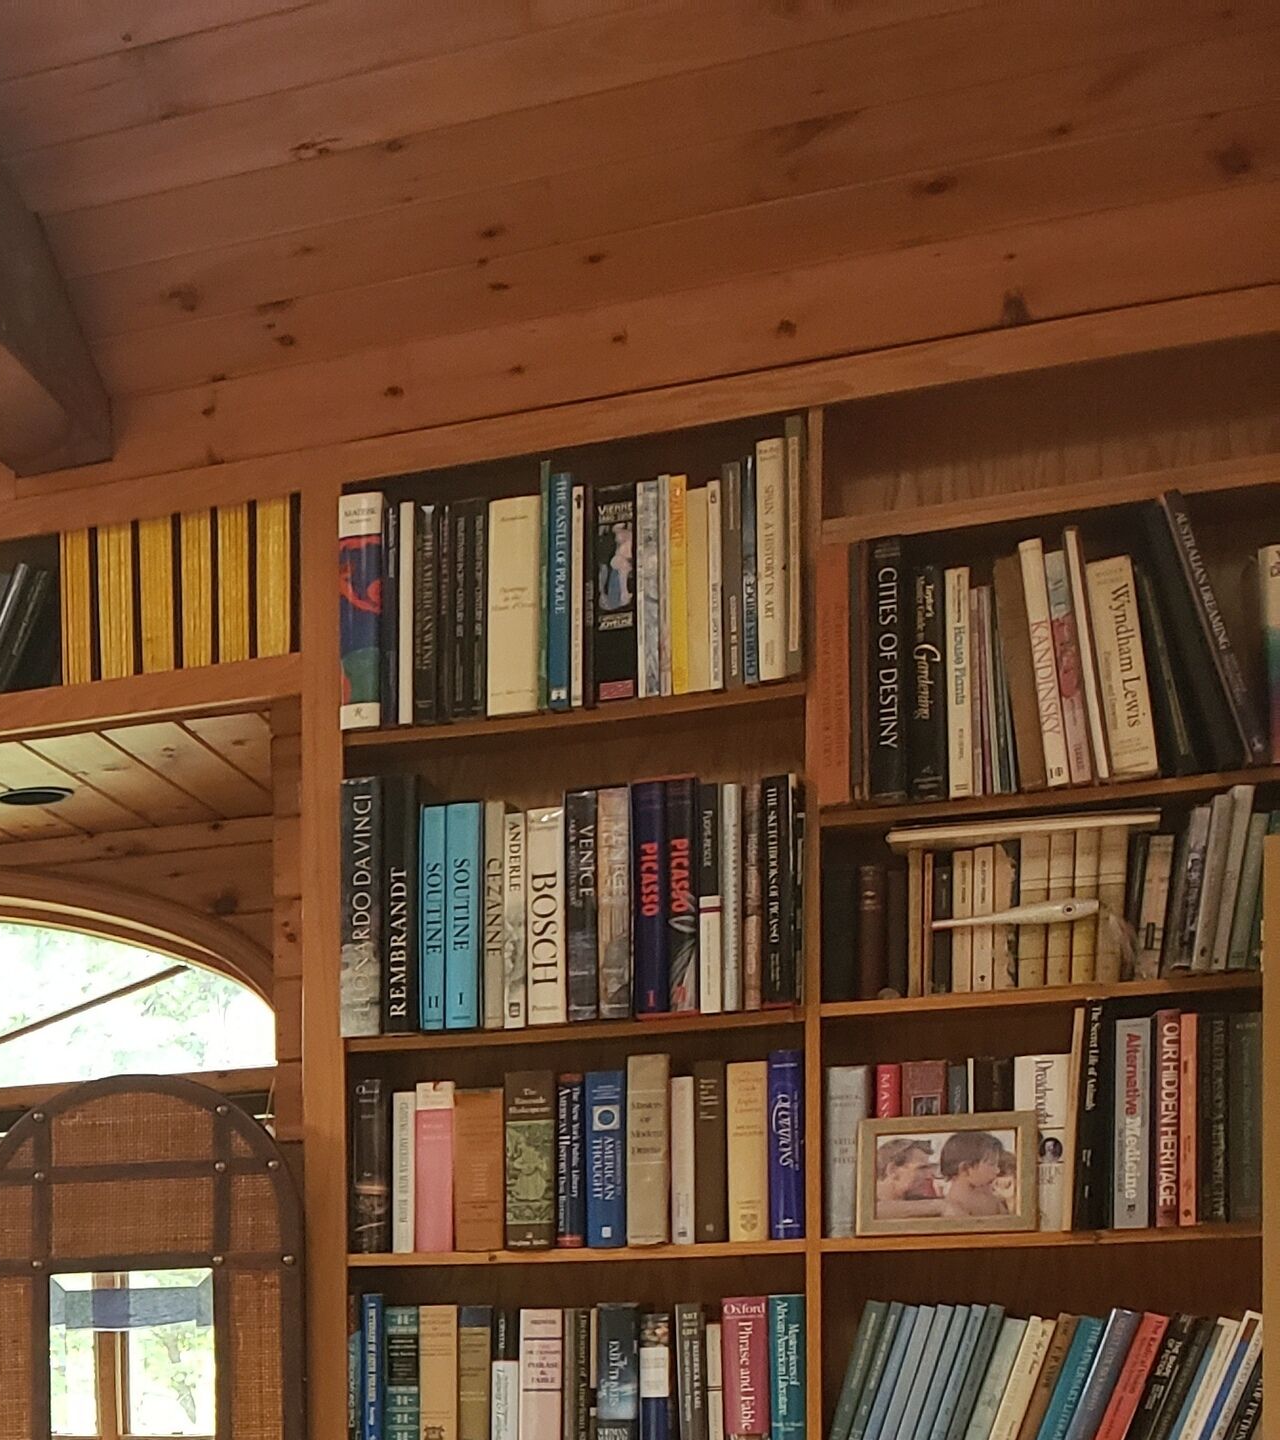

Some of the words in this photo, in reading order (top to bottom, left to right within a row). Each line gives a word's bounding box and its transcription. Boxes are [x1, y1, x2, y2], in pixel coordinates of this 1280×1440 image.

[555, 480, 568, 504] THE
[555, 505, 568, 549] CASTLE
[555, 550, 568, 566] OF
[763, 532, 775, 579] HISTORY
[555, 567, 568, 615] PRAGUE
[745, 580, 757, 622] BRIDGE
[763, 583, 775, 595] IN
[878, 567, 898, 626] CITIES
[1174, 511, 1207, 587] AUSTRALIAN
[1199, 585, 1231, 651] DREAMING
[763, 601, 775, 620] ART
[745, 625, 757, 676] CHARLES
[878, 633, 898, 660] OF
[953, 626, 966, 665] House
[1107, 583, 1135, 673] Wyndham
[1121, 676, 1146, 729] Lewis
[913, 643, 941, 721] Gardening
[953, 668, 966, 705] Plants
[1030, 620, 1060, 735] KANDINSKY
[878, 668, 898, 749] DESTINY
[766, 787, 779, 806] THE
[509, 821, 521, 892] ANDERLE
[579, 824, 595, 897] VENICE
[766, 810, 779, 884] SKETCHBOOKS
[640, 842, 659, 917] PICASSO
[670, 837, 690, 913] PICASSO
[766, 885, 779, 900] OF
[425, 862, 442, 955] SOUTINE
[453, 858, 470, 951] SOUTINE
[766, 901, 779, 943] PICASSO
[389, 866, 407, 1017] REMBRANDT
[531, 870, 558, 987] BOSCH
[1089, 1022, 1101, 1047] Secret
[1091, 1005, 1102, 1021] The
[1088, 1049, 1099, 1067] Life
[1160, 1022, 1179, 1059] OUR
[1126, 1032, 1142, 1117] Alternative
[1160, 1061, 1179, 1123] HIDDEN
[571, 1103, 580, 1120] New
[571, 1123, 580, 1140] York
[571, 1143, 580, 1167] Public
[592, 1138, 603, 1200] THOUGHT
[604, 1136, 615, 1200] AMERICAN
[1126, 1118, 1142, 1201] Medicine
[1159, 1126, 1178, 1207] HERITAGE
[570, 1169, 580, 1198] Library
[723, 1301, 766, 1315] Oxford
[578, 1315, 588, 1365] Dictionary
[738, 1321, 753, 1365] Phrase
[578, 1367, 588, 1379] of
[739, 1367, 755, 1392] and
[578, 1382, 588, 1429] American
[740, 1395, 756, 1431] Fable
[777, 1376, 790, 1417] Literature
